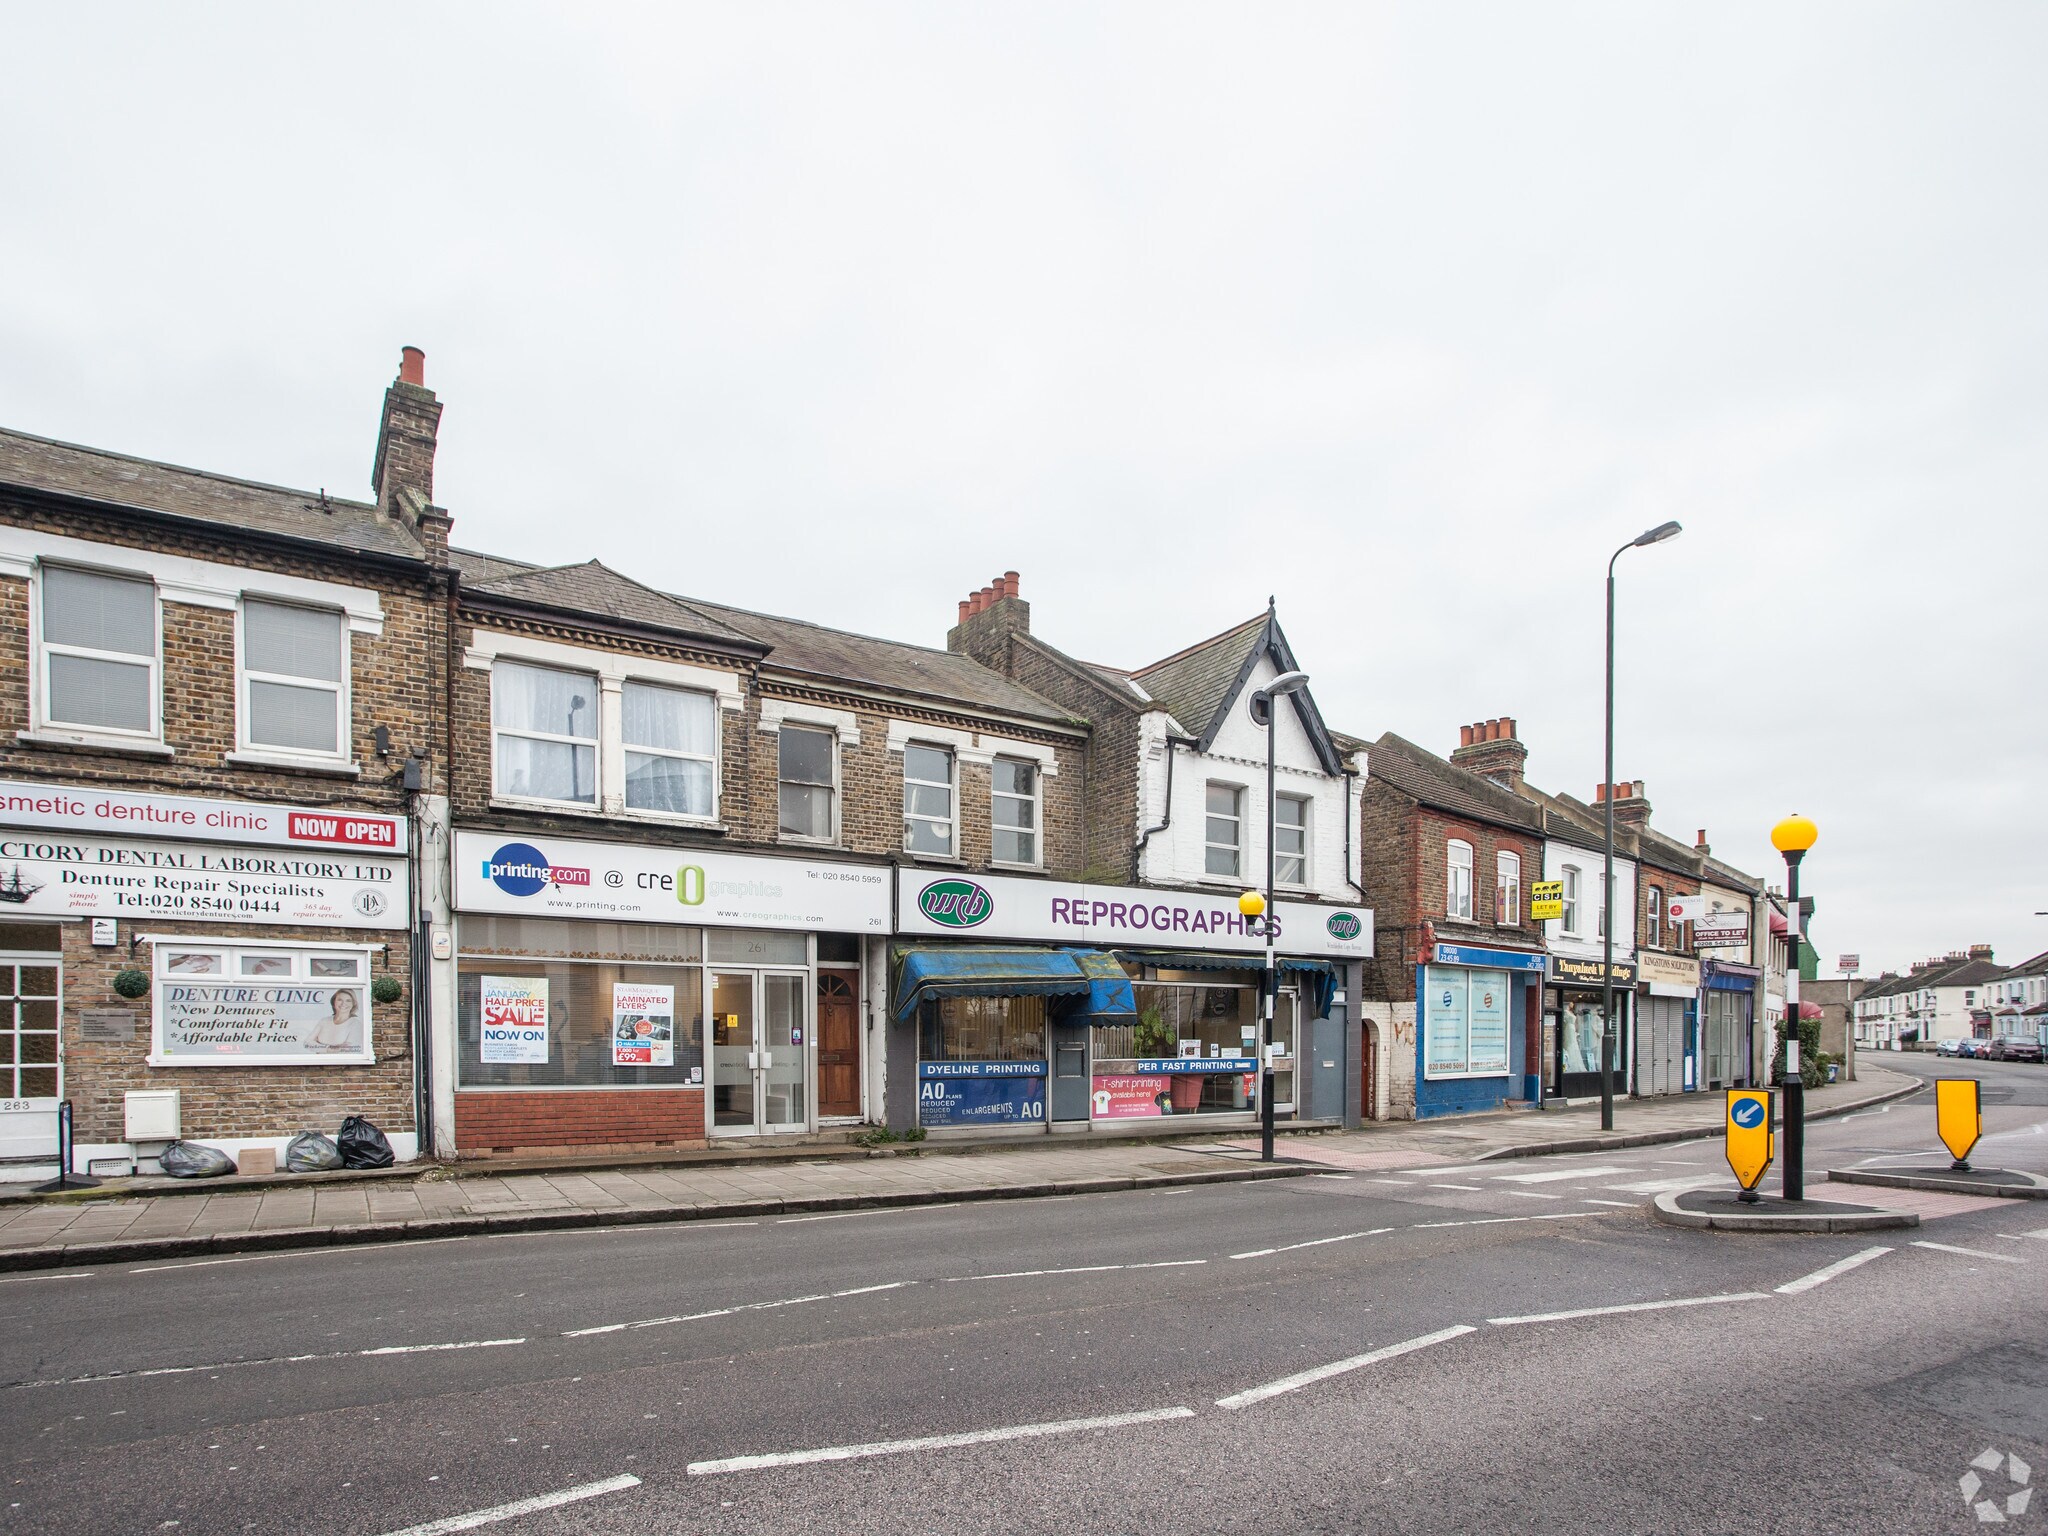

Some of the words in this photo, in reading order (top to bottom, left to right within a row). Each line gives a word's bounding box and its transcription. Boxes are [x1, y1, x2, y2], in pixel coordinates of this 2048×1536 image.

[95, 801, 196, 825] denture
[205, 810, 268, 831] clinic
[294, 817, 338, 838] NOW
[345, 822, 391, 842] OPEN
[0, 841, 89, 862] CTORY
[98, 848, 192, 869] DENTAL
[201, 855, 348, 878] LABORATORY
[355, 865, 393, 881] LTD
[489, 861, 588, 883] printing.com
[603, 870, 624, 889] @
[806, 870, 821, 879] Tel:
[822, 871, 838, 881] 020
[839, 873, 860, 882] 8540
[861, 875, 882, 884] 5959
[61, 869, 147, 888] Denture
[153, 875, 221, 891] Repair
[227, 879, 325, 898] Specialists
[69, 892, 99, 901] simply
[68, 900, 99, 908] phone
[190, 895, 233, 912] 8540
[239, 899, 281, 913] 0444
[303, 903, 318, 911] 365
[319, 905, 333, 913] day
[546, 899, 641, 912] www.printing.com
[292, 911, 314, 919] repair
[716, 909, 825, 924] www.creographics.com
[1598, 962, 1631, 981] Wdings
[171, 987, 260, 1002] DENTURE
[264, 989, 325, 1003] CLINIC
[485, 989, 532, 998] JANUARY
[485, 997, 513, 1006] HALF
[515, 998, 545, 1007] PRICE
[616, 996, 668, 1004] LAMINATED
[213, 1004, 275, 1016] Dentures
[616, 1002, 647, 1010] FLYERS
[484, 1006, 545, 1027] SALE
[268, 1019, 289, 1029] Fit
[256, 1032, 298, 1043] Prices
[485, 1030, 521, 1041] NOW
[523, 1031, 544, 1041] ON
[618, 1053, 637, 1061] £99
[927, 1065, 980, 1075] DYELINE
[985, 1064, 1041, 1074] PRINTING
[1138, 1062, 1158, 1071] PER
[1162, 1061, 1187, 1071] FAST
[1189, 1061, 1233, 1070] PRINTING
[1102, 1078, 1130, 1089] T-shirt
[1131, 1078, 1162, 1091] printing
[1111, 1091, 1136, 1099] available
[3, 1100, 30, 1111] 263
[961, 1101, 1014, 1116] ENLARGEMENTS
